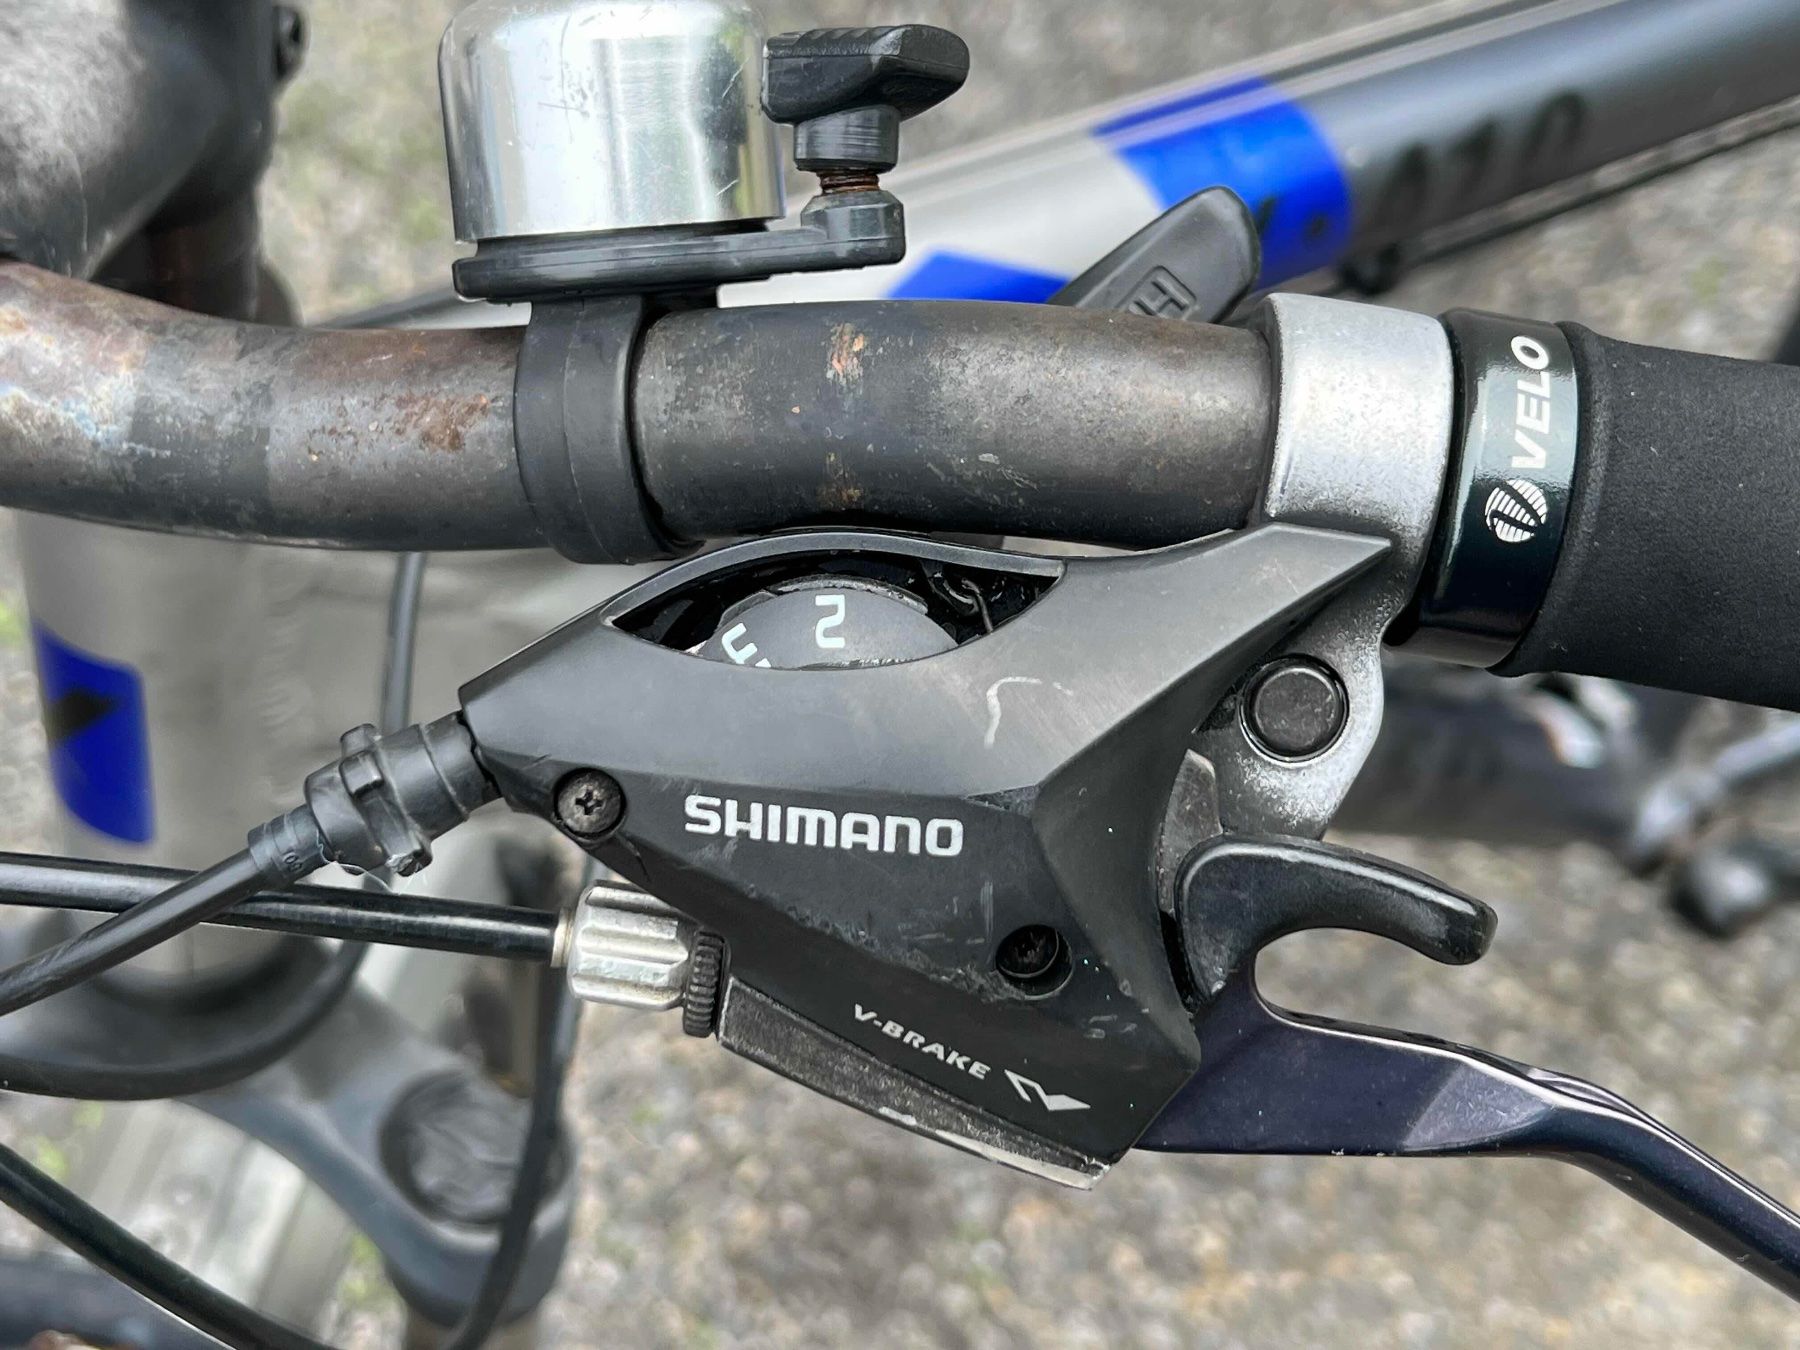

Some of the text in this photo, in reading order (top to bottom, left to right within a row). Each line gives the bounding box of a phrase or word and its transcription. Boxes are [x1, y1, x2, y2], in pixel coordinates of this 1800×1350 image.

[1510, 335, 1550, 469] VELO
[815, 594, 846, 648] 2
[684, 794, 964, 857] SHIMANO
[854, 1003, 991, 1080] V-BRAKE
